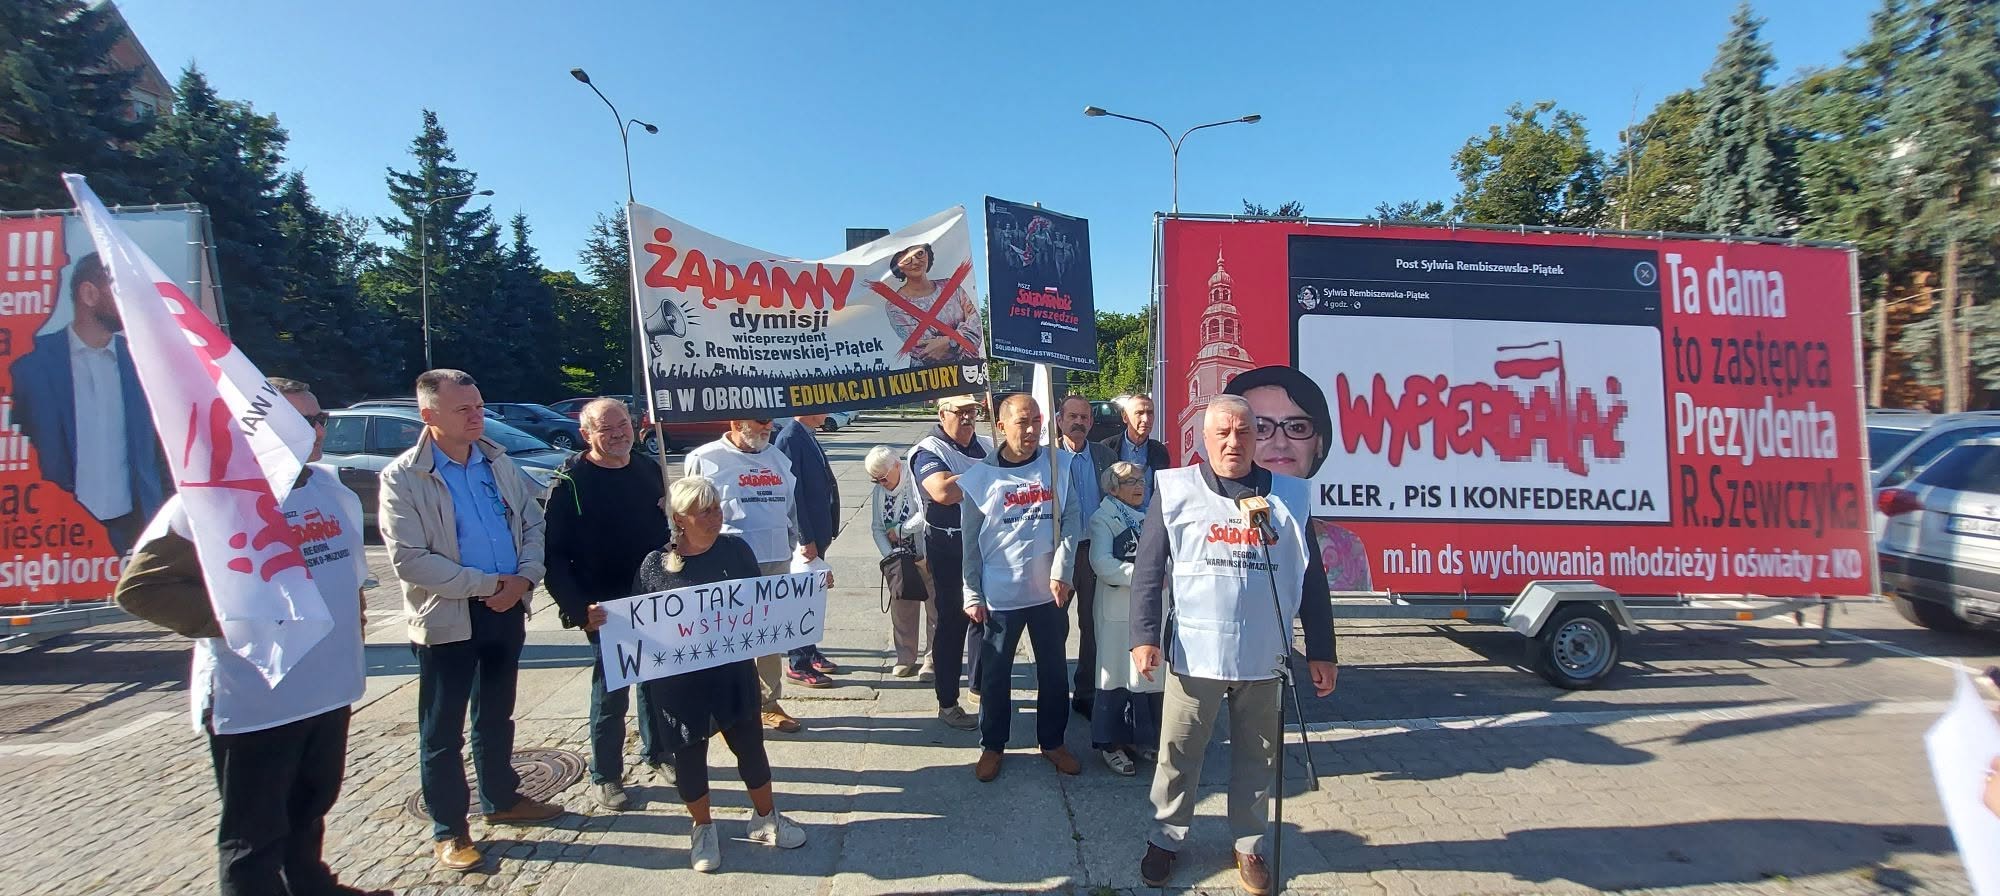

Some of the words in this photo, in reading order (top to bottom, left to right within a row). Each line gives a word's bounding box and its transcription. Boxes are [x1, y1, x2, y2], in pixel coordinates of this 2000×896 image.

[643, 228, 855, 310] ŻĄDAMY
[1396, 258, 1419, 270] Post
[1421, 259, 1455, 273] Sylwia
[1456, 261, 1564, 277] Rembiszewska-Piątek
[1323, 288, 1348, 298] Sylwia
[1349, 289, 1430, 300] Rembiszewska-Piątek
[1665, 253, 1699, 315] Ta
[1707, 256, 1786, 318] dama
[1009, 304, 1031, 317] jest
[1033, 309, 1079, 325] wszędzie
[1323, 300, 1329, 308] 4
[1330, 300, 1349, 309] godz.
[730, 308, 829, 333] dymisji
[684, 341, 701, 359] S.
[706, 337, 884, 361] Rembiszewskiej-Piątek
[733, 332, 827, 346] wiceprezydent
[1673, 328, 1703, 384] to
[1711, 331, 1831, 398] zastępca
[677, 388, 696, 412] W
[702, 387, 786, 412] OBRONIE
[789, 377, 875, 408] EDUKACJI
[878, 379, 886, 398] I
[889, 365, 959, 396] KULTURY
[1674, 393, 1839, 466] Prezydenta
[1320, 484, 1382, 507] KLER
[1404, 485, 1441, 508] PiS
[1450, 487, 1456, 509] I
[1463, 487, 1656, 512] KONFEDERACJA
[1682, 464, 1859, 538] R.Szewczyka
[1232, 550, 1257, 560] REGION
[1383, 544, 1433, 574] m.in
[1437, 544, 1463, 575] ds
[1469, 545, 1605, 584] wychowania
[1610, 546, 1717, 582] młodzieży
[1720, 547, 1729, 577] i
[1733, 549, 1812, 582] oświaty
[1817, 554, 1829, 578] z
[629, 593, 684, 629] KTO
[694, 583, 745, 612] TAK
